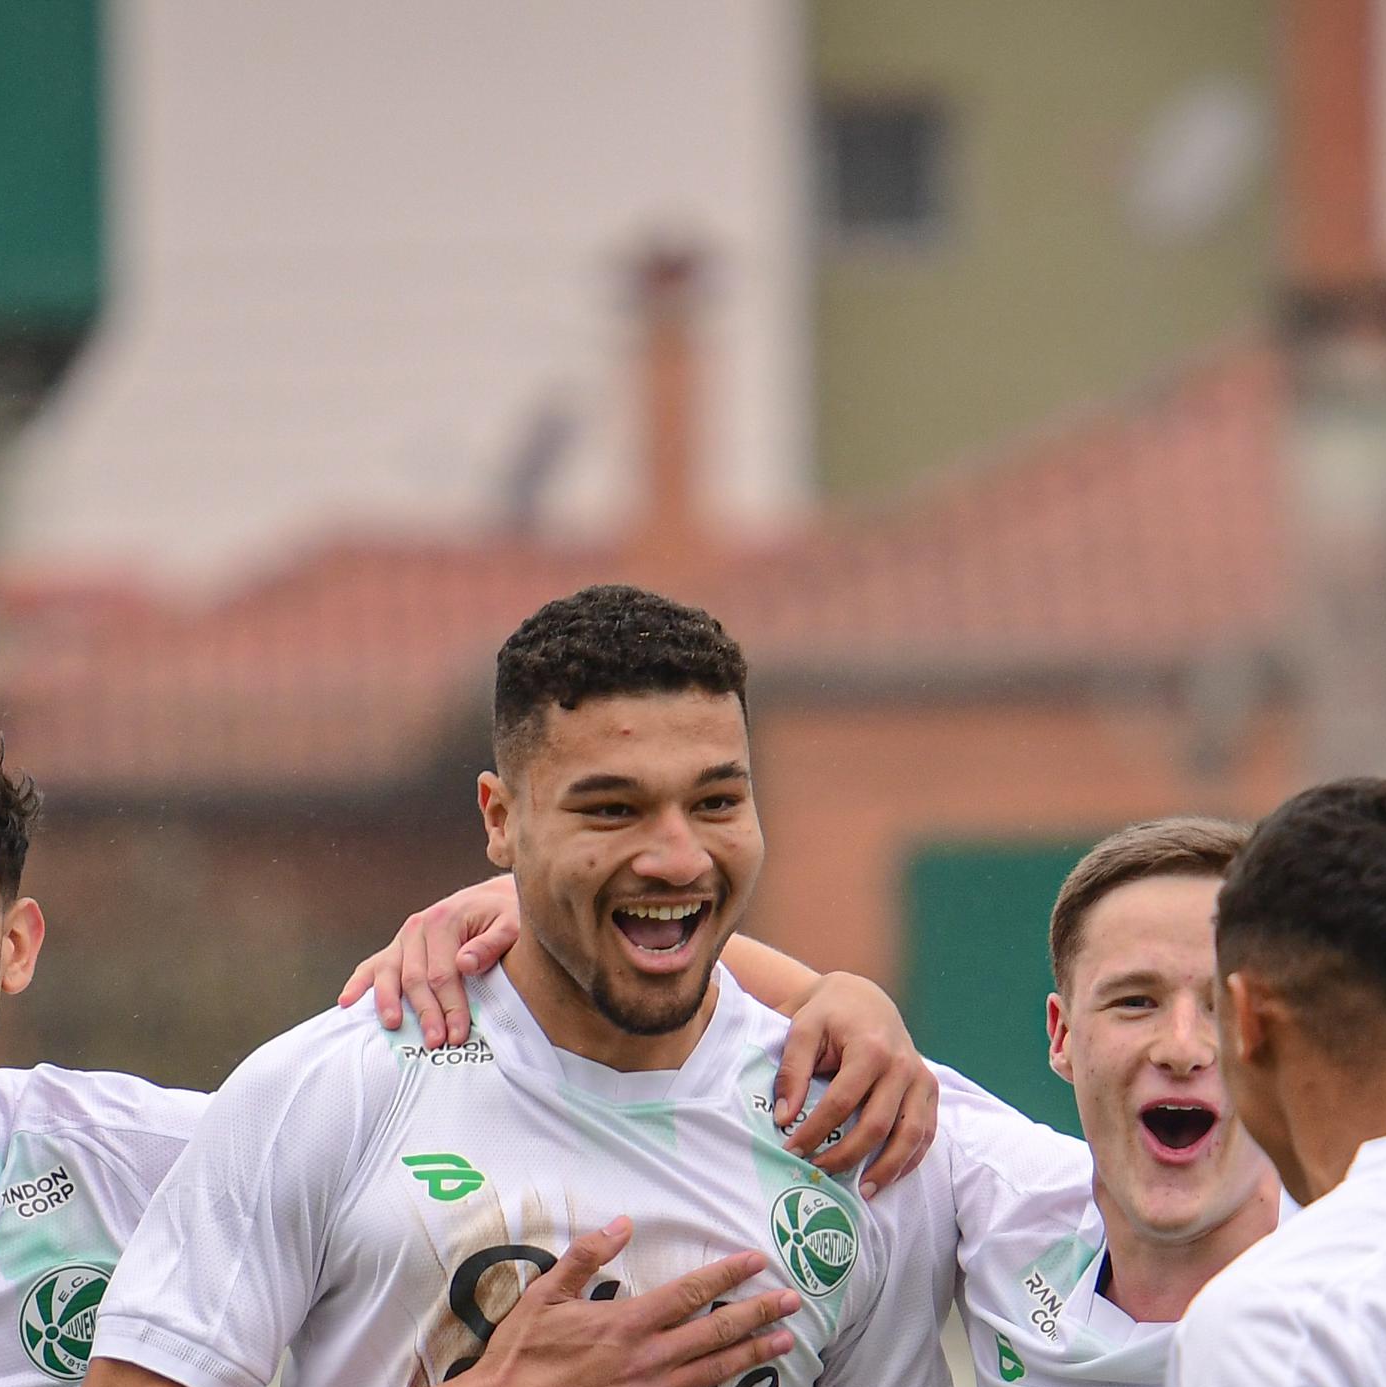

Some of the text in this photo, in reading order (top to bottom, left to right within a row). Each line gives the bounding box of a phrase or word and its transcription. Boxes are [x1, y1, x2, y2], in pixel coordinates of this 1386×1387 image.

[431, 1051, 494, 1066] CORP
[18, 1182, 75, 1218] CORP
[58, 1276, 89, 1303] E.C.
[1025, 1272, 1063, 1318] RAN
